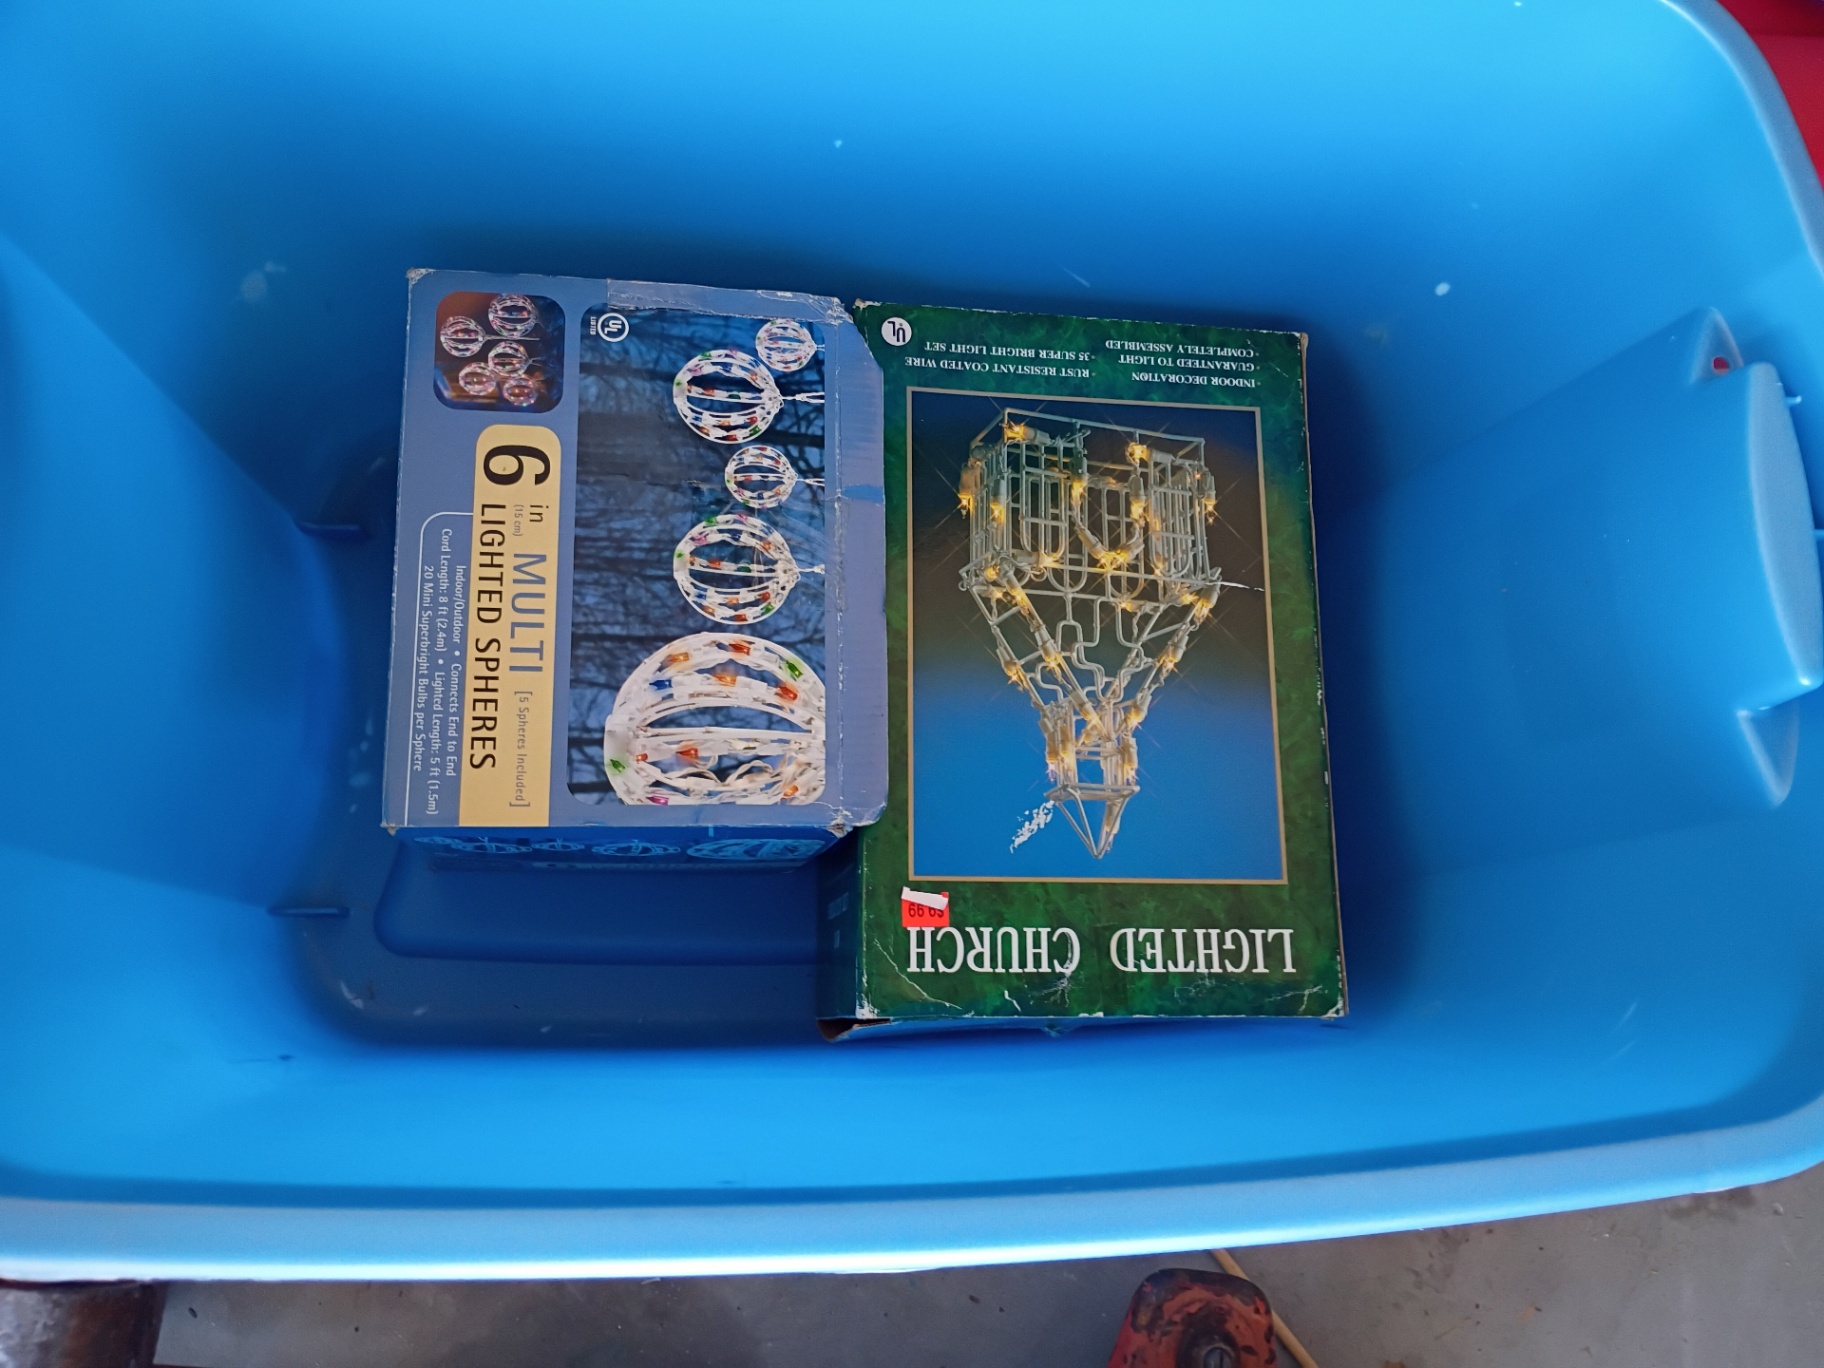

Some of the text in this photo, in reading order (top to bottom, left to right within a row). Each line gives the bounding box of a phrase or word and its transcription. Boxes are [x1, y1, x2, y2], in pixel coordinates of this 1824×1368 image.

[924, 341, 1091, 361] 35 SUPER BRIGHT LIGHT SET
[1105, 339, 1254, 358] COMPLETELY ASSEMBLED
[1118, 354, 1255, 372] GUARANTEED TO LIGHT
[904, 356, 1090, 378] RUST RESISTANT COATED WIRE
[1131, 371, 1256, 388] INDOOR DECORATION
[483, 444, 551, 486] 6
[529, 503, 549, 523] in
[441, 528, 452, 552] Cord
[437, 555, 451, 593] Length:
[437, 605, 449, 615] ft
[509, 553, 547, 672] MULTI
[434, 616, 449, 652] (2.4m)
[469, 504, 506, 769] LIGHTED SPHERES
[412, 566, 434, 772] 20 Mini Superbright Bulbs per Sphere
[445, 565, 467, 776] Indoor/Outdoor Connects End to End
[431, 671, 446, 711] Lighted
[428, 713, 443, 754] Length:
[516, 705, 530, 750] Spheres
[428, 767, 441, 777] ft
[430, 757, 441, 765] 5
[425, 780, 440, 815] (1.5m)
[906, 926, 1297, 974] LIGHTED CHURCH
